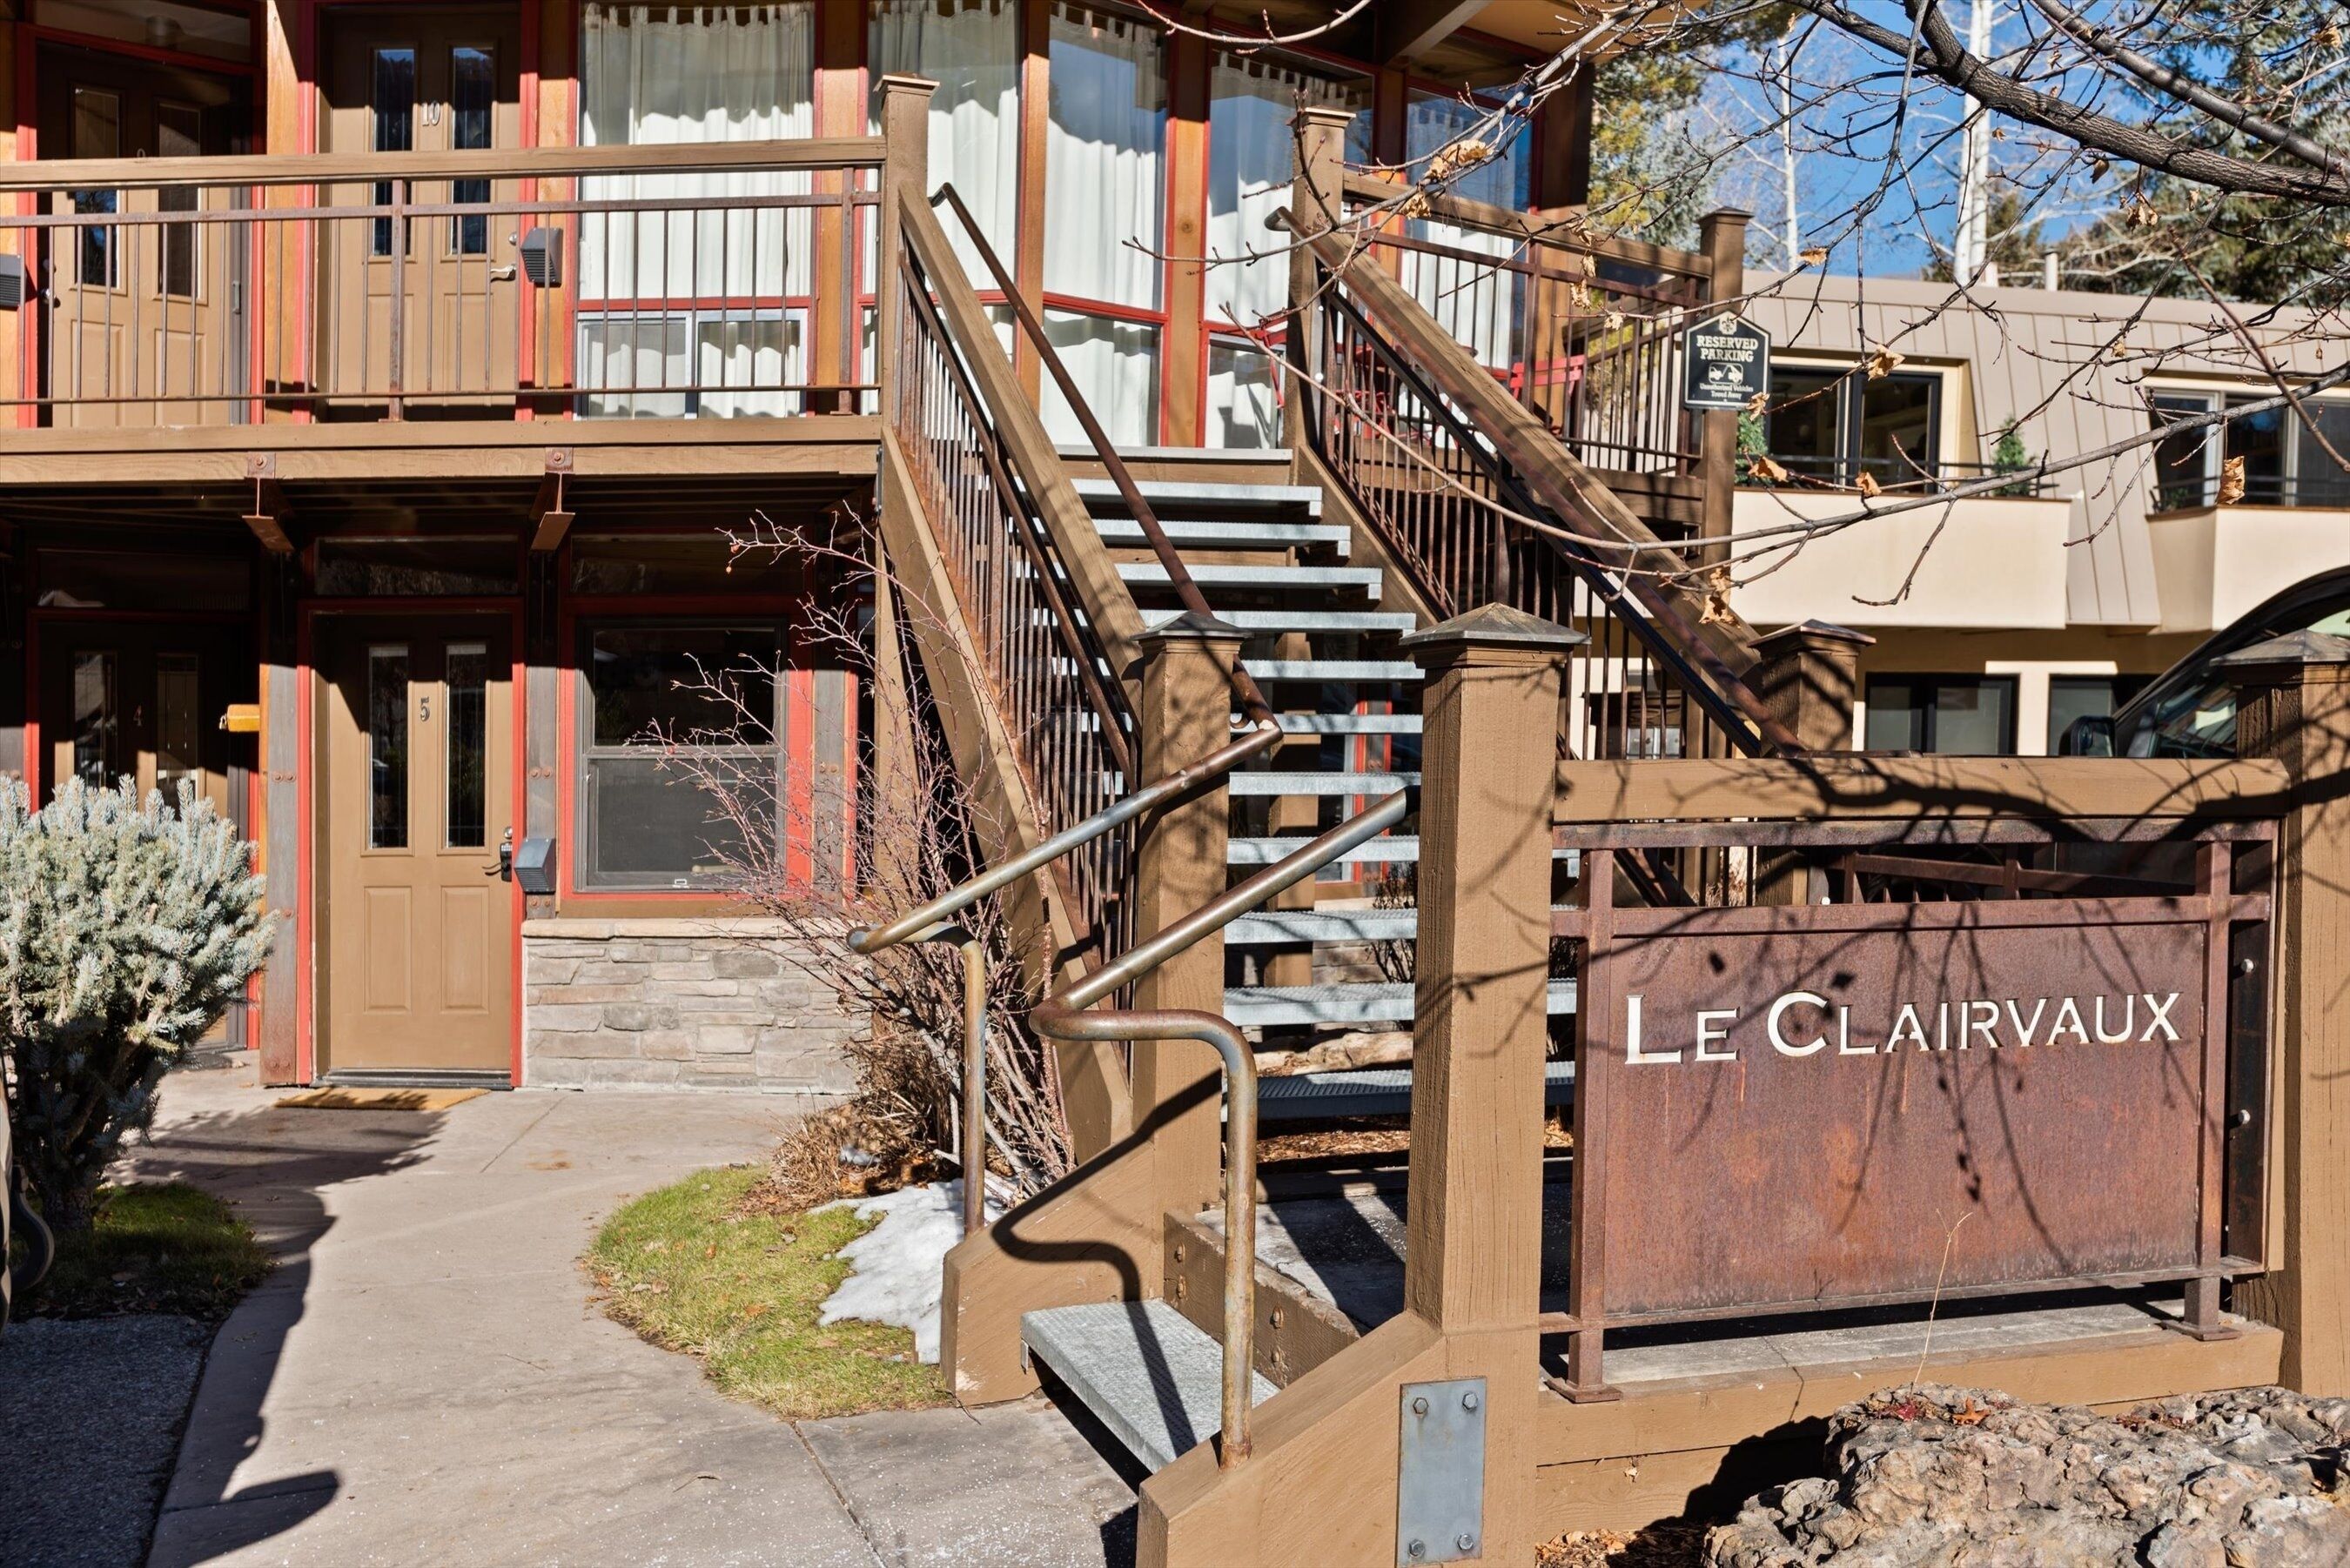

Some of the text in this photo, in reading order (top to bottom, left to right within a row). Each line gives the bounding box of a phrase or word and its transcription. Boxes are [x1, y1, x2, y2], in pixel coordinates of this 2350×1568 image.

[421, 102, 440, 126] 10
[1696, 335, 1758, 350] RESERVED
[1700, 348, 1754, 362] PARKING
[420, 696, 430, 722] 5
[1768, 990, 2181, 1056] CLAIRVAUX
